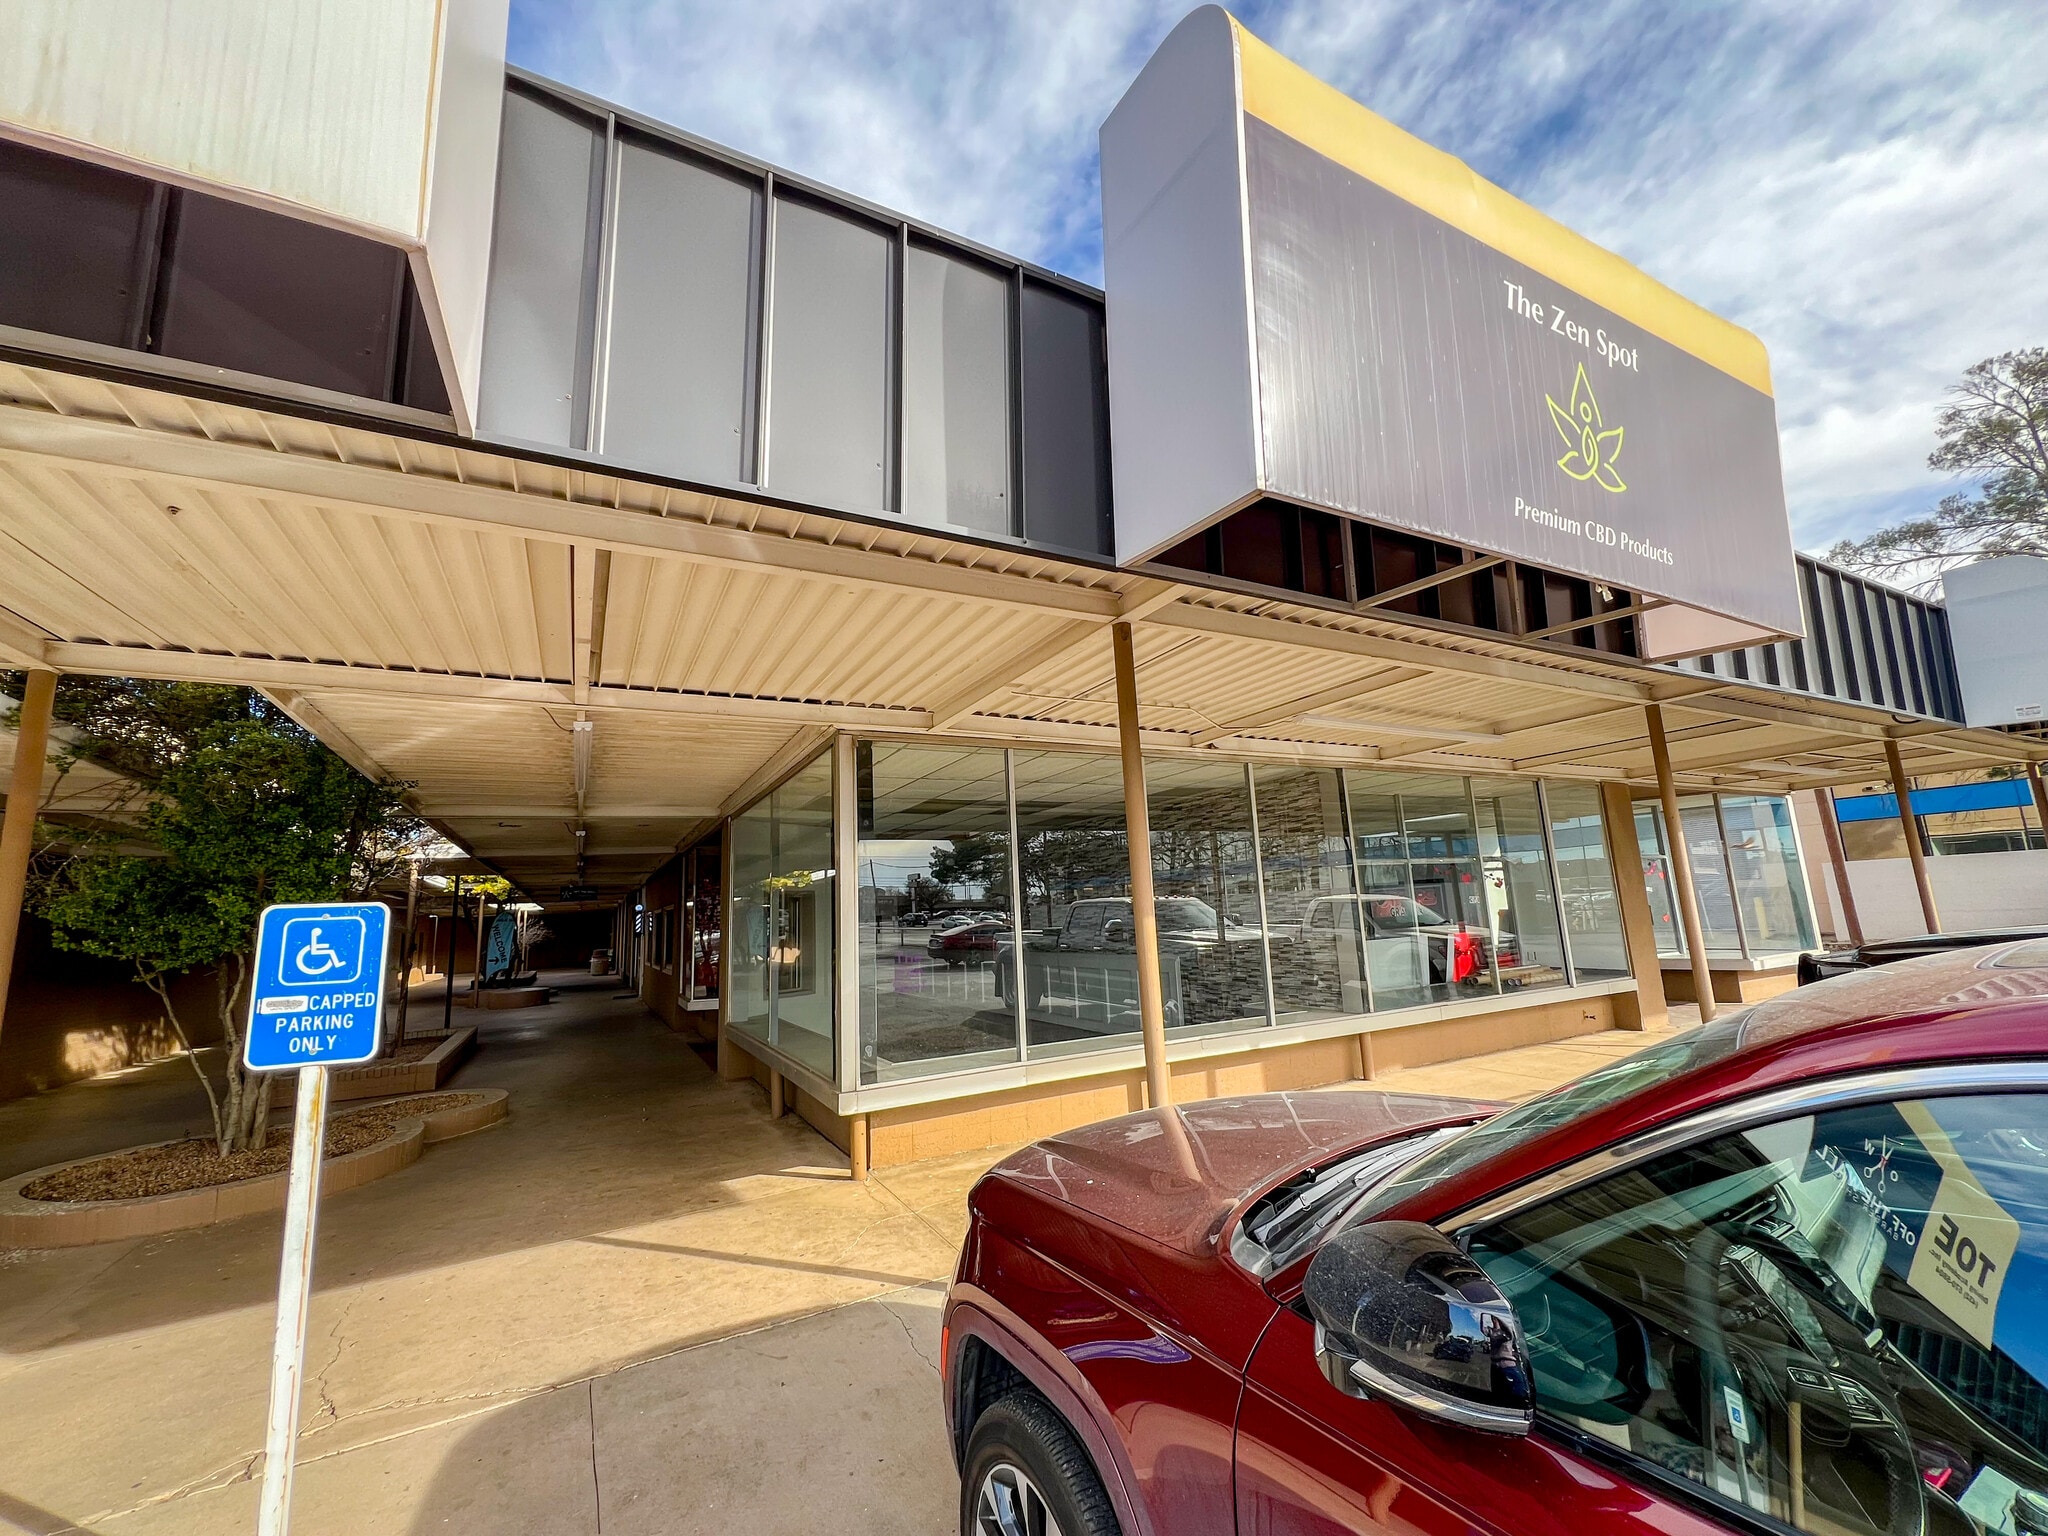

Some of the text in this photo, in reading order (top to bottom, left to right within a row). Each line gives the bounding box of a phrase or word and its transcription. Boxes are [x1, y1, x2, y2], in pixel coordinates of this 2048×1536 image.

[1503, 280, 1639, 372] The Zen Spot
[1514, 496, 1674, 566] Premium CBD Products
[491, 924, 508, 963] WELCOME
[275, 1013, 354, 1034] PARKING
[288, 1034, 337, 1054] ONLY
